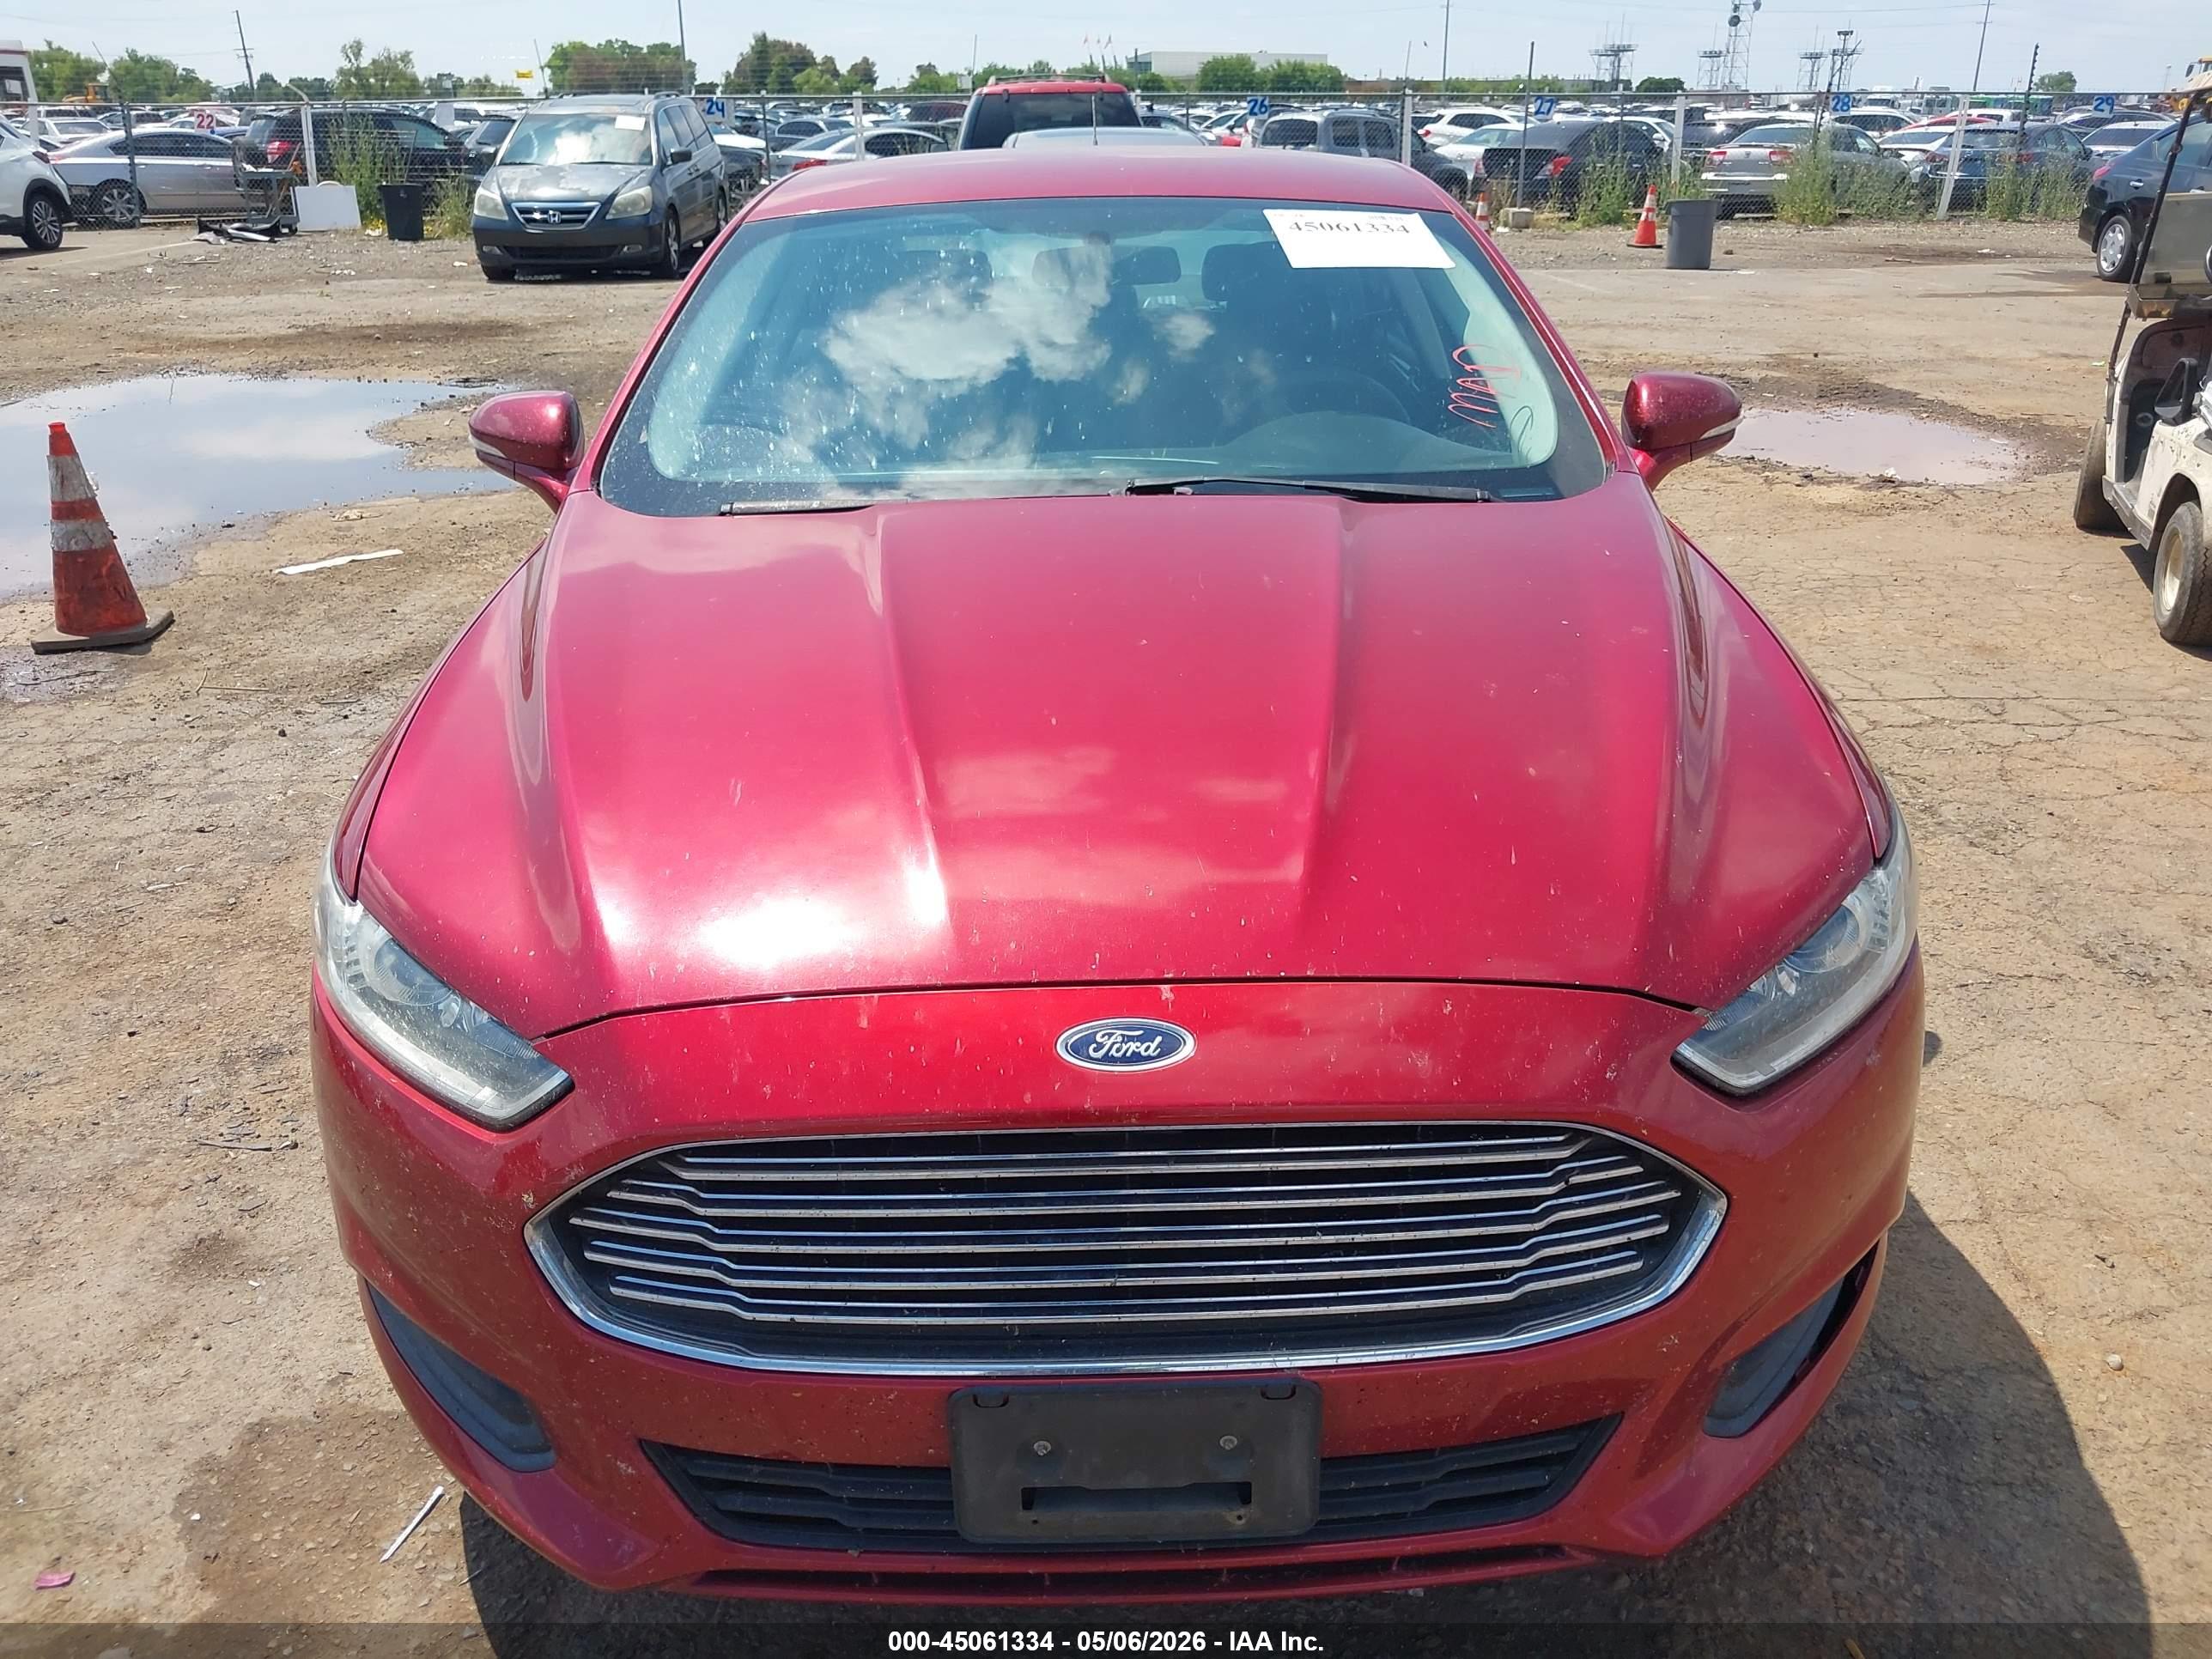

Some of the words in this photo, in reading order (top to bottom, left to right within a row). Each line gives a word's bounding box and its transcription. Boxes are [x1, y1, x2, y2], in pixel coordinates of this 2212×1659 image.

[705, 98, 726, 118] 24
[1248, 98, 1267, 116] 26
[1534, 96, 1556, 115] 27
[1832, 94, 1851, 112] 28
[2094, 95, 2114, 114] 29
[196, 113, 215, 129] 22
[1289, 221, 1411, 234] 45061334
[1089, 1030, 1163, 1058] Ford
